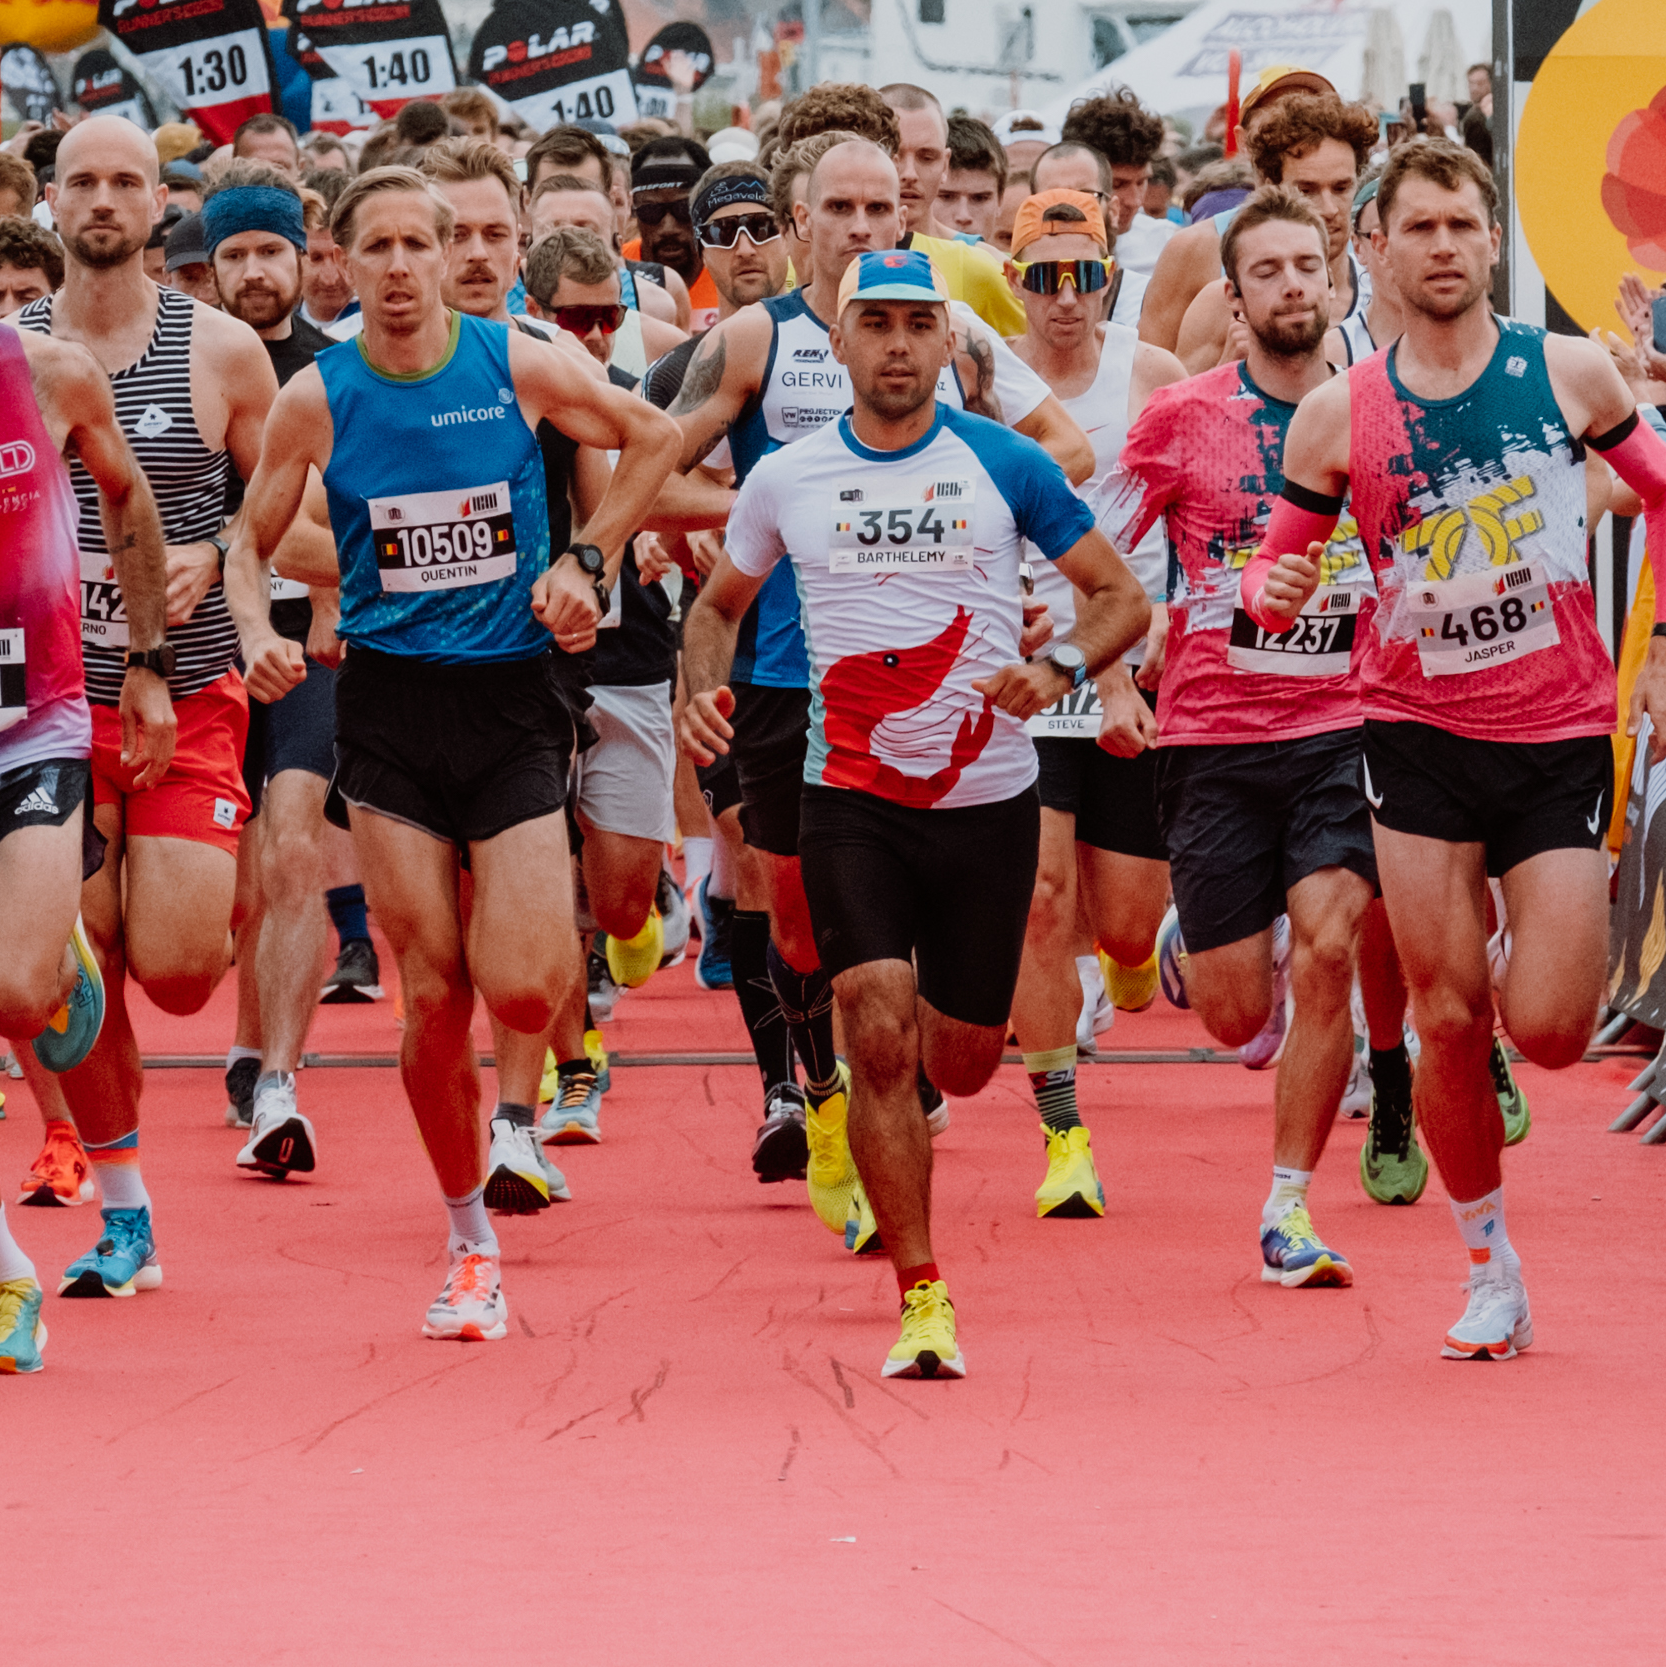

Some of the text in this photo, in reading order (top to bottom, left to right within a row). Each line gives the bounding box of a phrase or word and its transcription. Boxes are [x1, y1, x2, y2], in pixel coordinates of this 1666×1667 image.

[177, 43, 248, 97] 1:30
[362, 48, 431, 89] 1:40
[551, 86, 615, 122] 1:40
[431, 405, 506, 427] umicore
[856, 507, 946, 546] 354
[396, 521, 494, 567] 10509
[857, 550, 946, 564] BARTHELEMY
[420, 564, 478, 583] QUENTIN
[81, 621, 107, 636] RNO
[1440, 596, 1528, 647] 468
[1464, 640, 1516, 664] JASPER
[1047, 719, 1085, 730] STEVE
[14, 800, 60, 815] adidas
